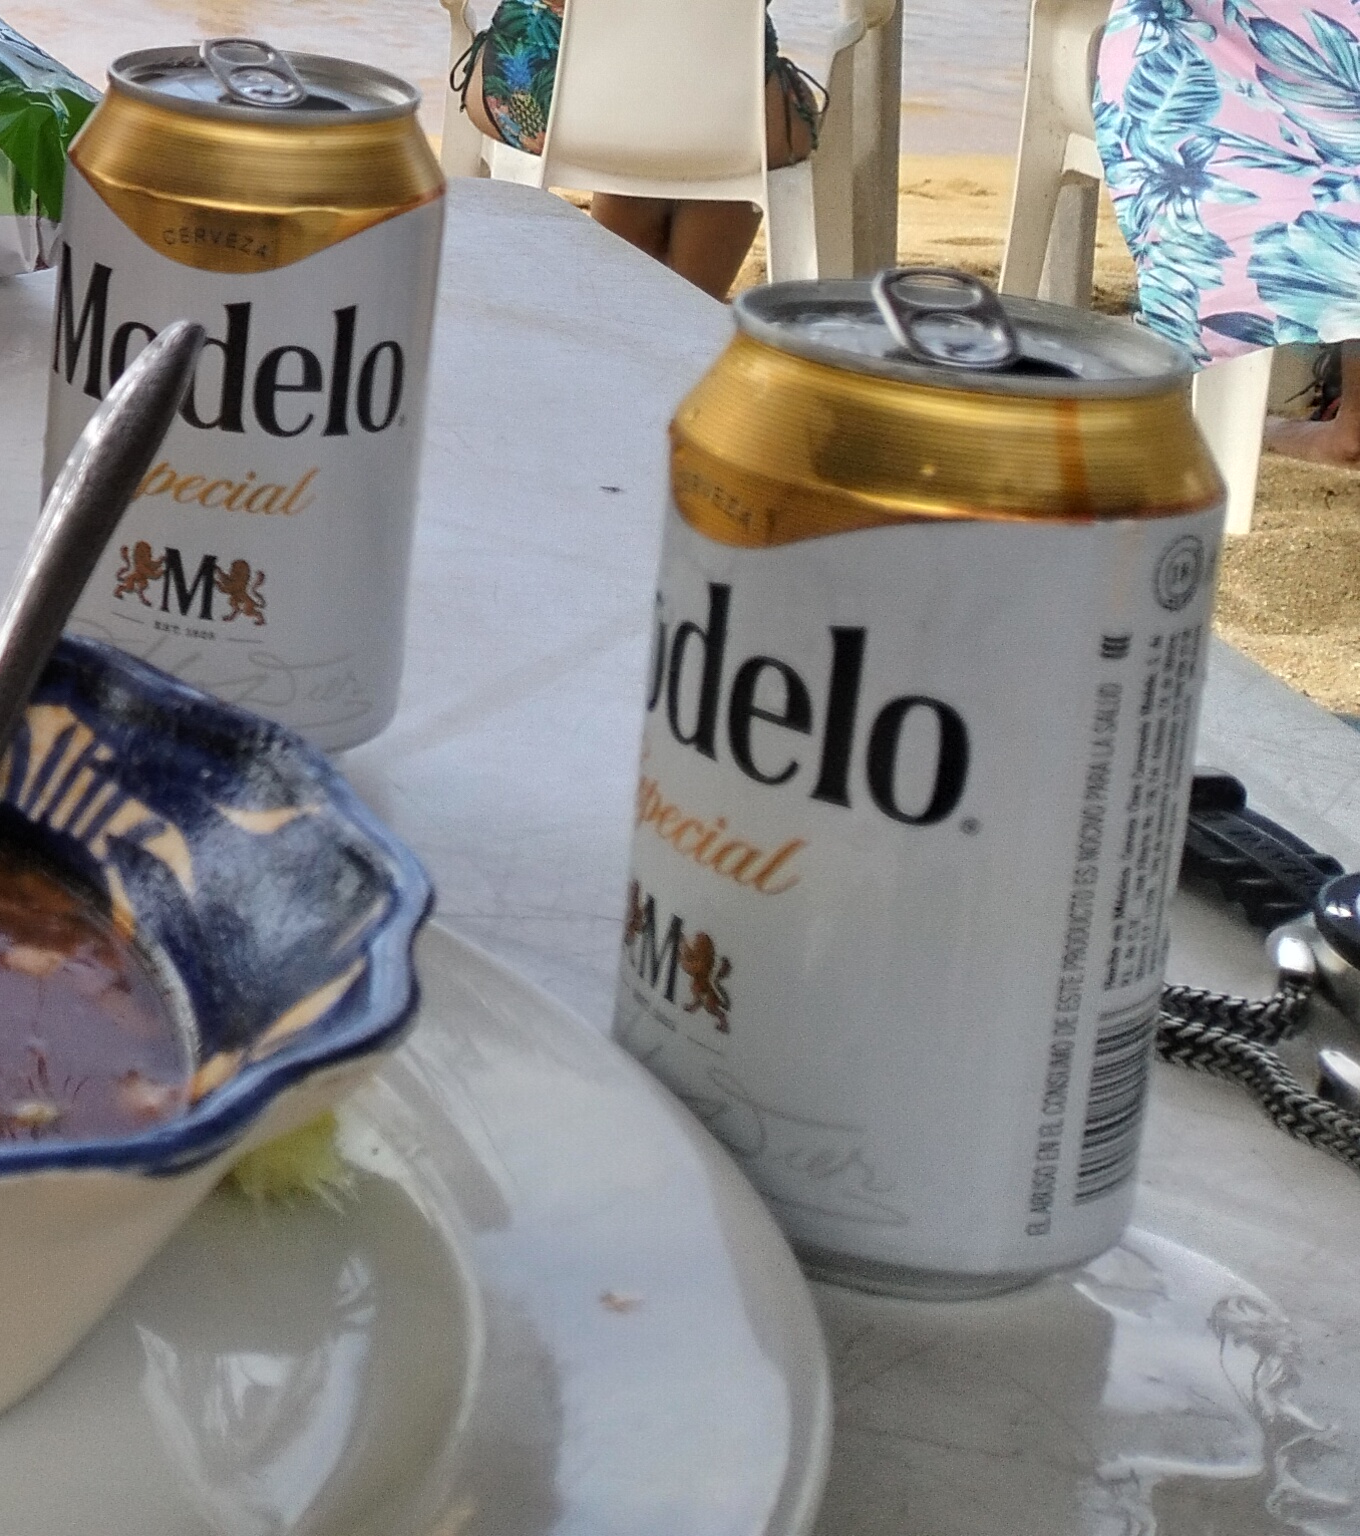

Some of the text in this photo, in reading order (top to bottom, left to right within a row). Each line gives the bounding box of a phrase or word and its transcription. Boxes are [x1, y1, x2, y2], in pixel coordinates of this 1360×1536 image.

[162, 226, 269, 257] CERVEZA
[160, 546, 218, 621] M
[648, 582, 971, 826] delo
